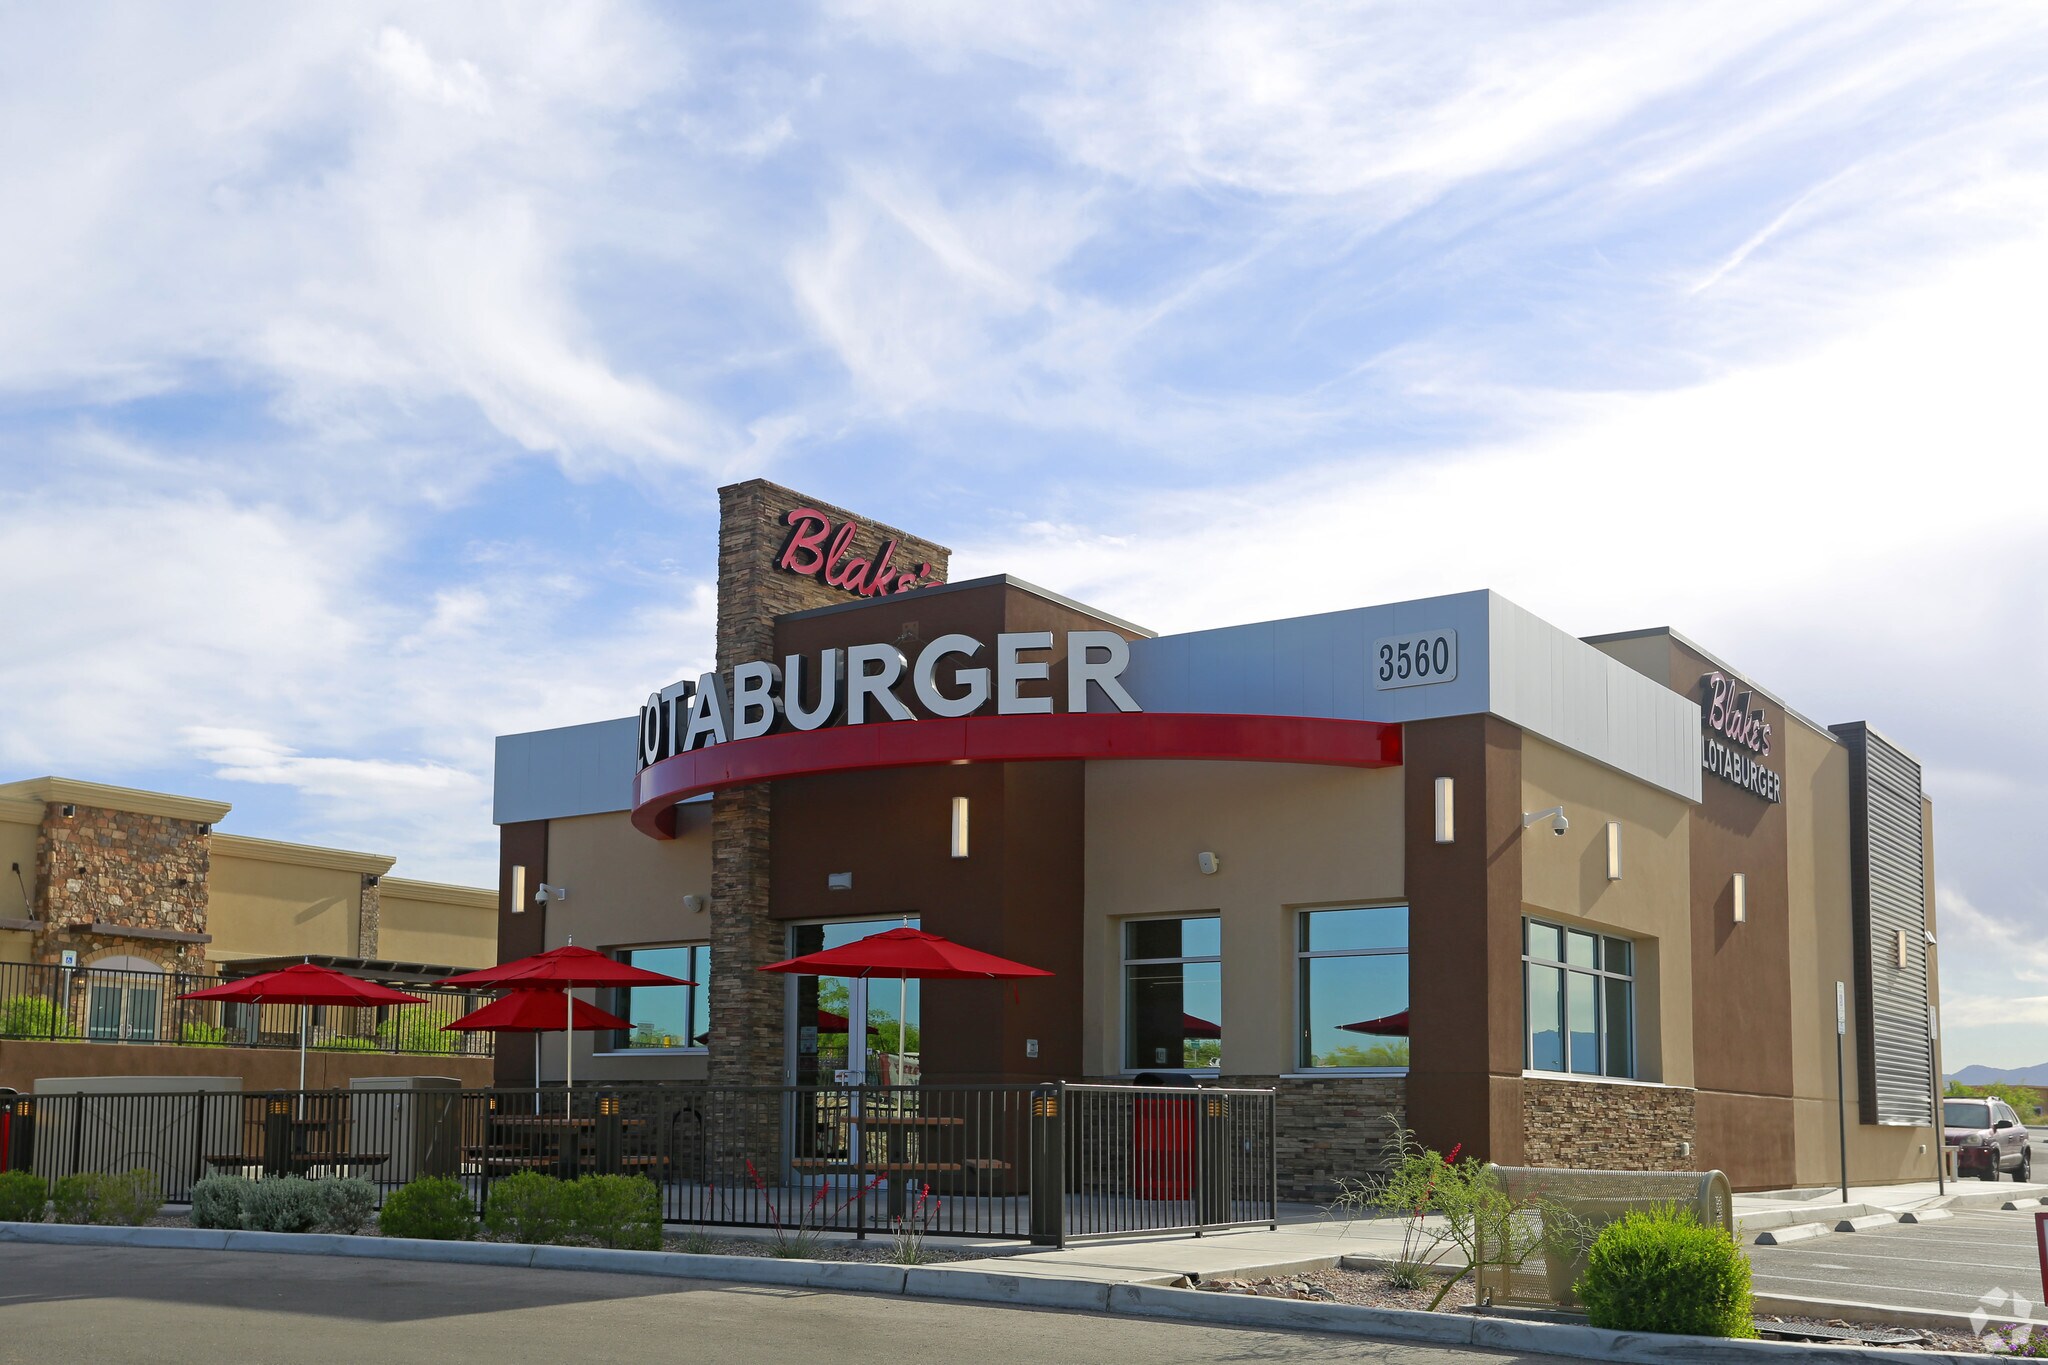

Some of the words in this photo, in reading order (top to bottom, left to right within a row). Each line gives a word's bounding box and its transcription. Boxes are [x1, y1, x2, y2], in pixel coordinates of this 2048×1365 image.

[781, 507, 945, 597] Blake'
[1379, 636, 1449, 682] 3560
[1707, 671, 1772, 757] Blake's
[1701, 735, 1781, 804] LOTABURGER
